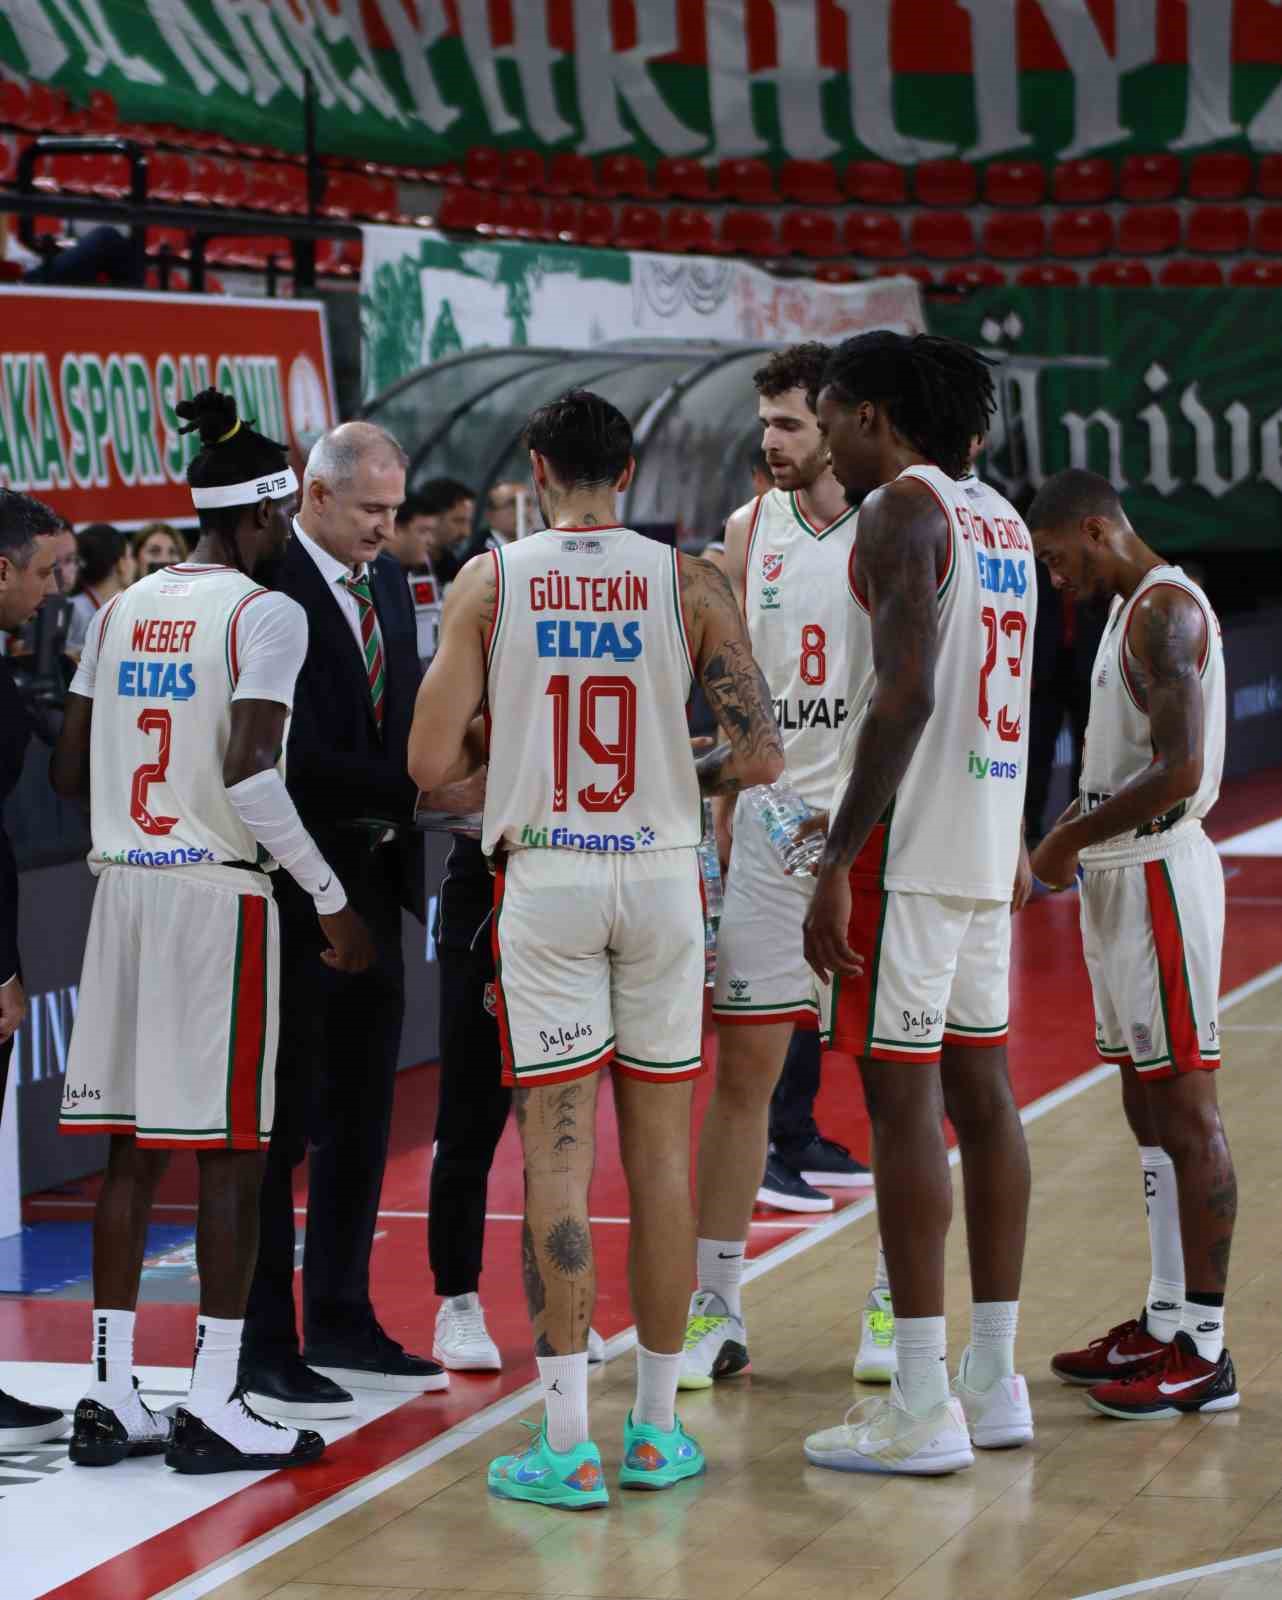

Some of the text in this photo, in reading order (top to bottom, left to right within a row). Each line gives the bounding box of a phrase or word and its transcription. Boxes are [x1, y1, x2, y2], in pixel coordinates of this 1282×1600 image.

[60, 351, 166, 489] SPOR
[256, 477, 287, 494] ELITE
[529, 570, 648, 612] GÜLTEKİN
[131, 619, 197, 652] WEBER
[800, 624, 826, 686] 8
[545, 674, 637, 813] 19
[130, 708, 180, 835] 2
[539, 1022, 592, 1053] Salados
